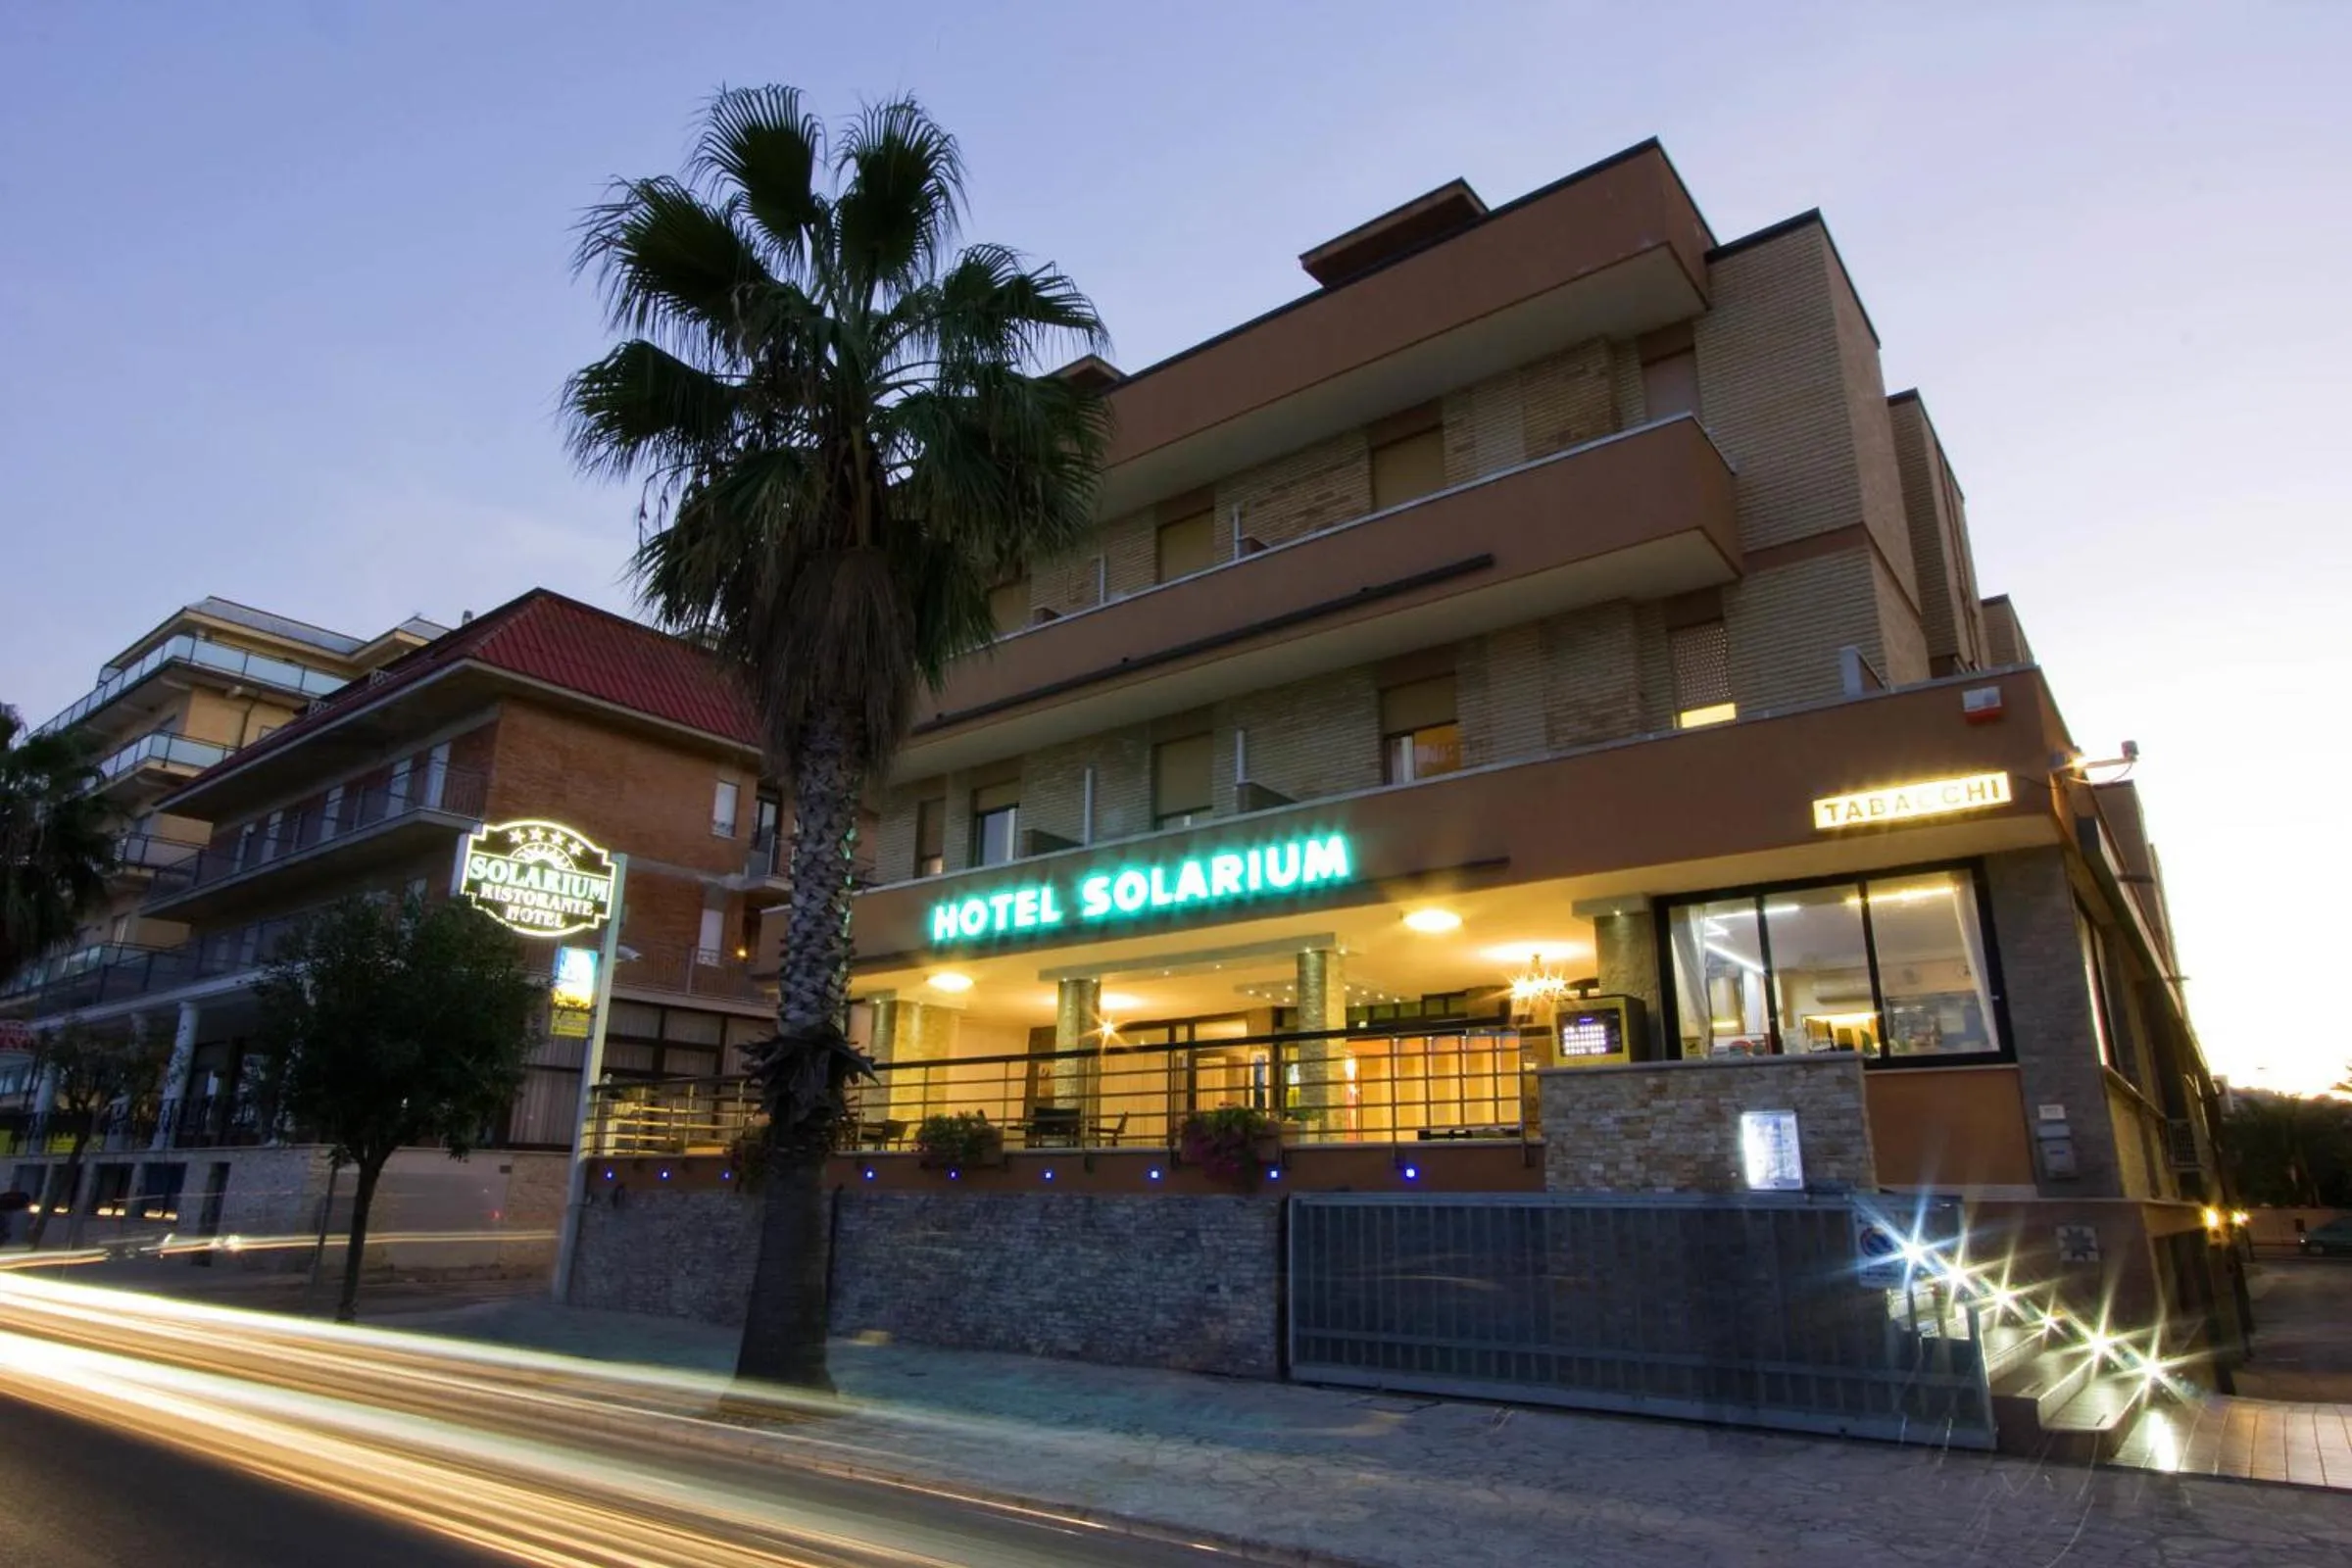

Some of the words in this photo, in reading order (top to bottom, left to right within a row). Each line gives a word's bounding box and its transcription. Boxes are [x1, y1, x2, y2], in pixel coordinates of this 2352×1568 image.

[1825, 779, 1999, 821] TABACCHI
[469, 857, 610, 902] SOLARIUM
[480, 883, 594, 915] RISTORANTE
[933, 886, 1061, 941] HOTEL
[1081, 835, 1349, 917] SOLARIUM
[505, 905, 565, 928] HOTEL
